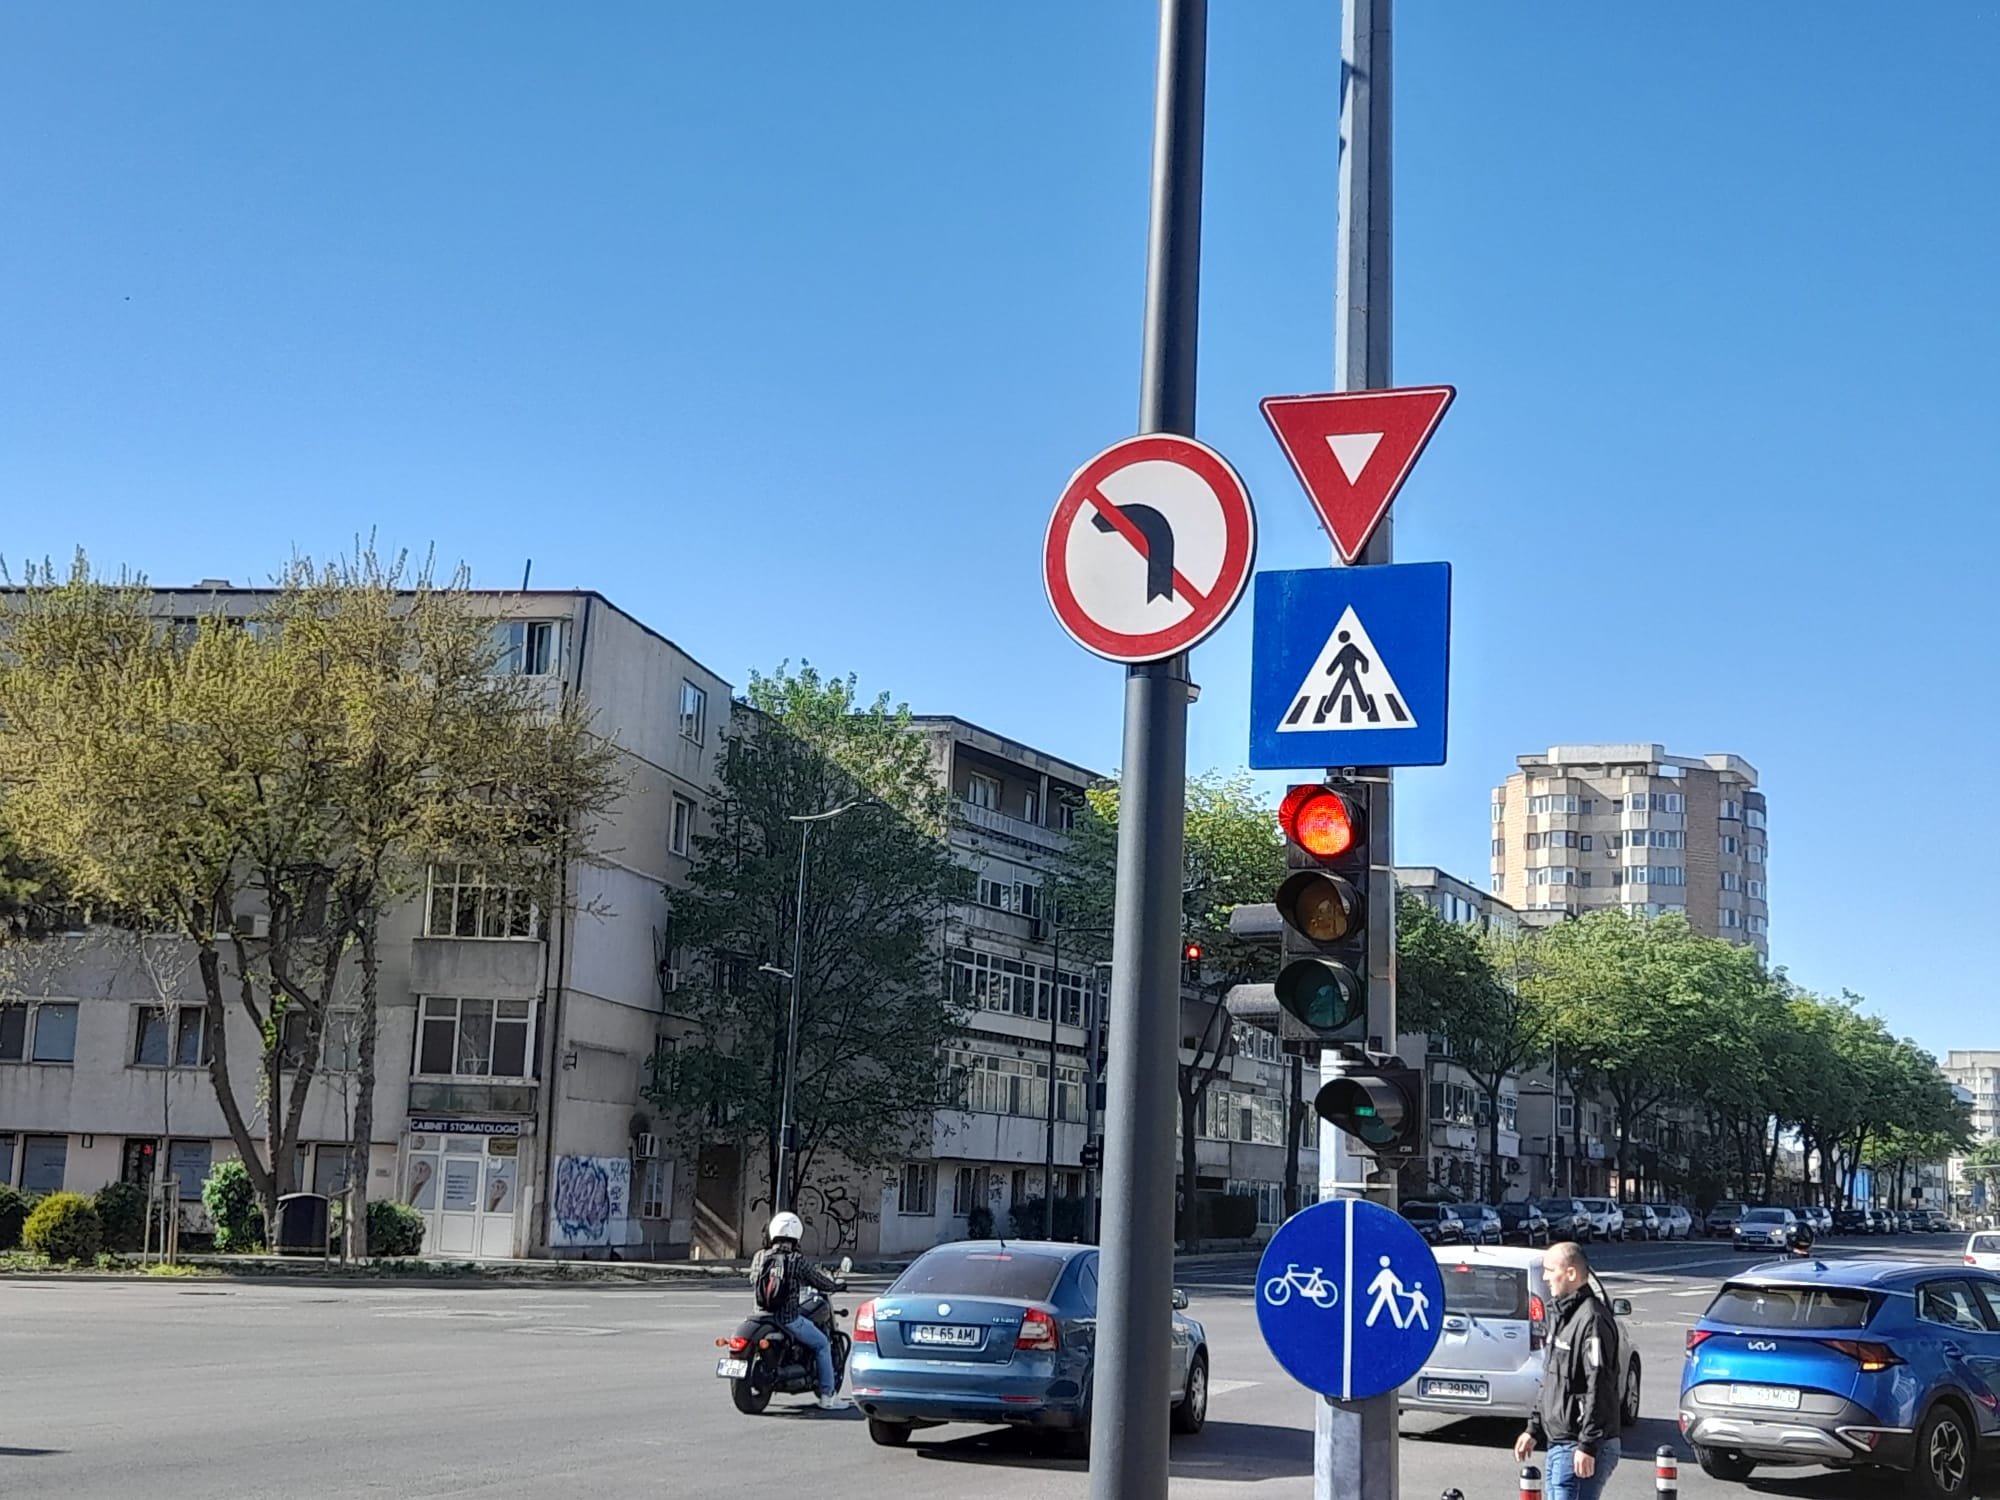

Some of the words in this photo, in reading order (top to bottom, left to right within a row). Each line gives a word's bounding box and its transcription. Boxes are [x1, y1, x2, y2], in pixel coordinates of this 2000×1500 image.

[411, 1121, 448, 1131] CABINET
[449, 1123, 519, 1134] STOMATOLOGIC
[920, 1326, 936, 1340] CT
[940, 1327, 954, 1340] 65
[1429, 1381, 1444, 1393] CT
